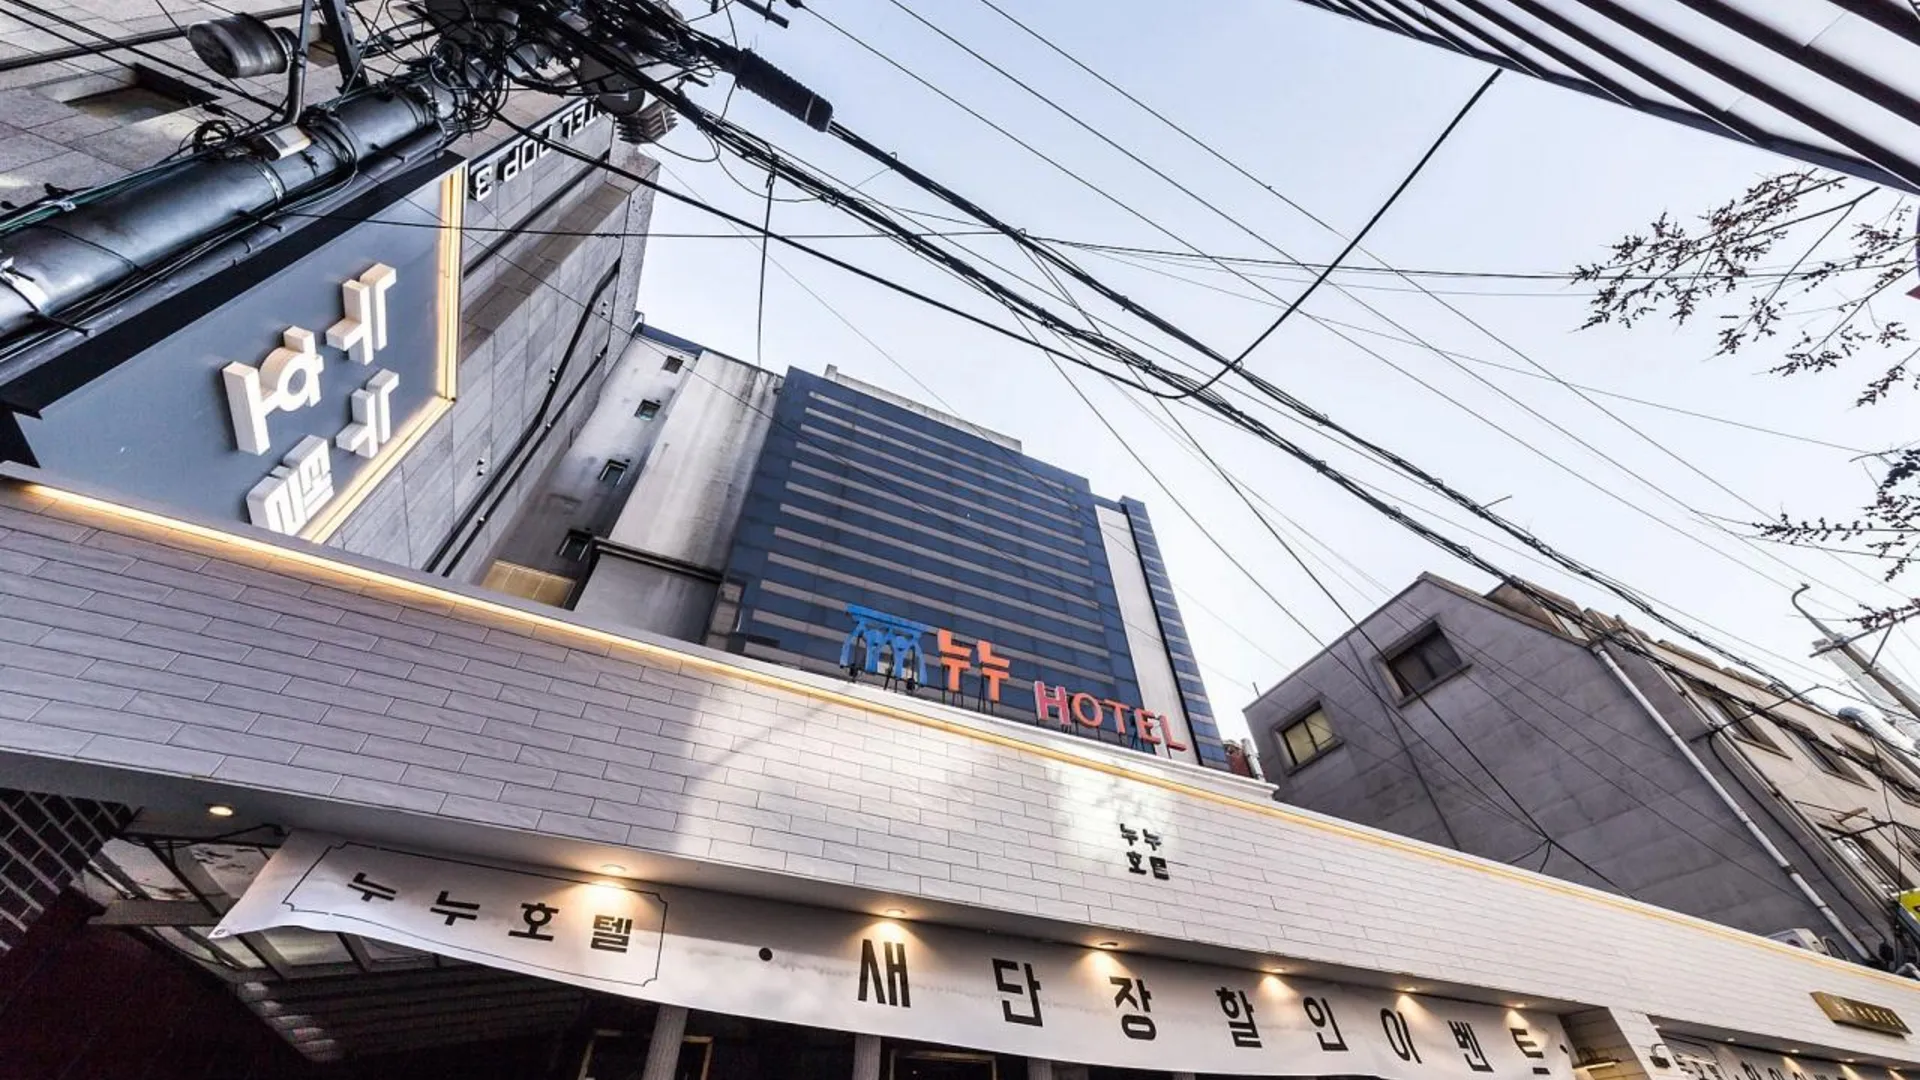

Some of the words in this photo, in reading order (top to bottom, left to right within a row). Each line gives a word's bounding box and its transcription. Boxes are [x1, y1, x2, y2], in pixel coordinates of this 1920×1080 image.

[475, 164, 493, 202] 3
[936, 628, 1010, 702] 누누
[1034, 680, 1187, 751] HOTEL
[1119, 823, 1161, 851] 누누
[347, 872, 633, 954] 누누호텔
